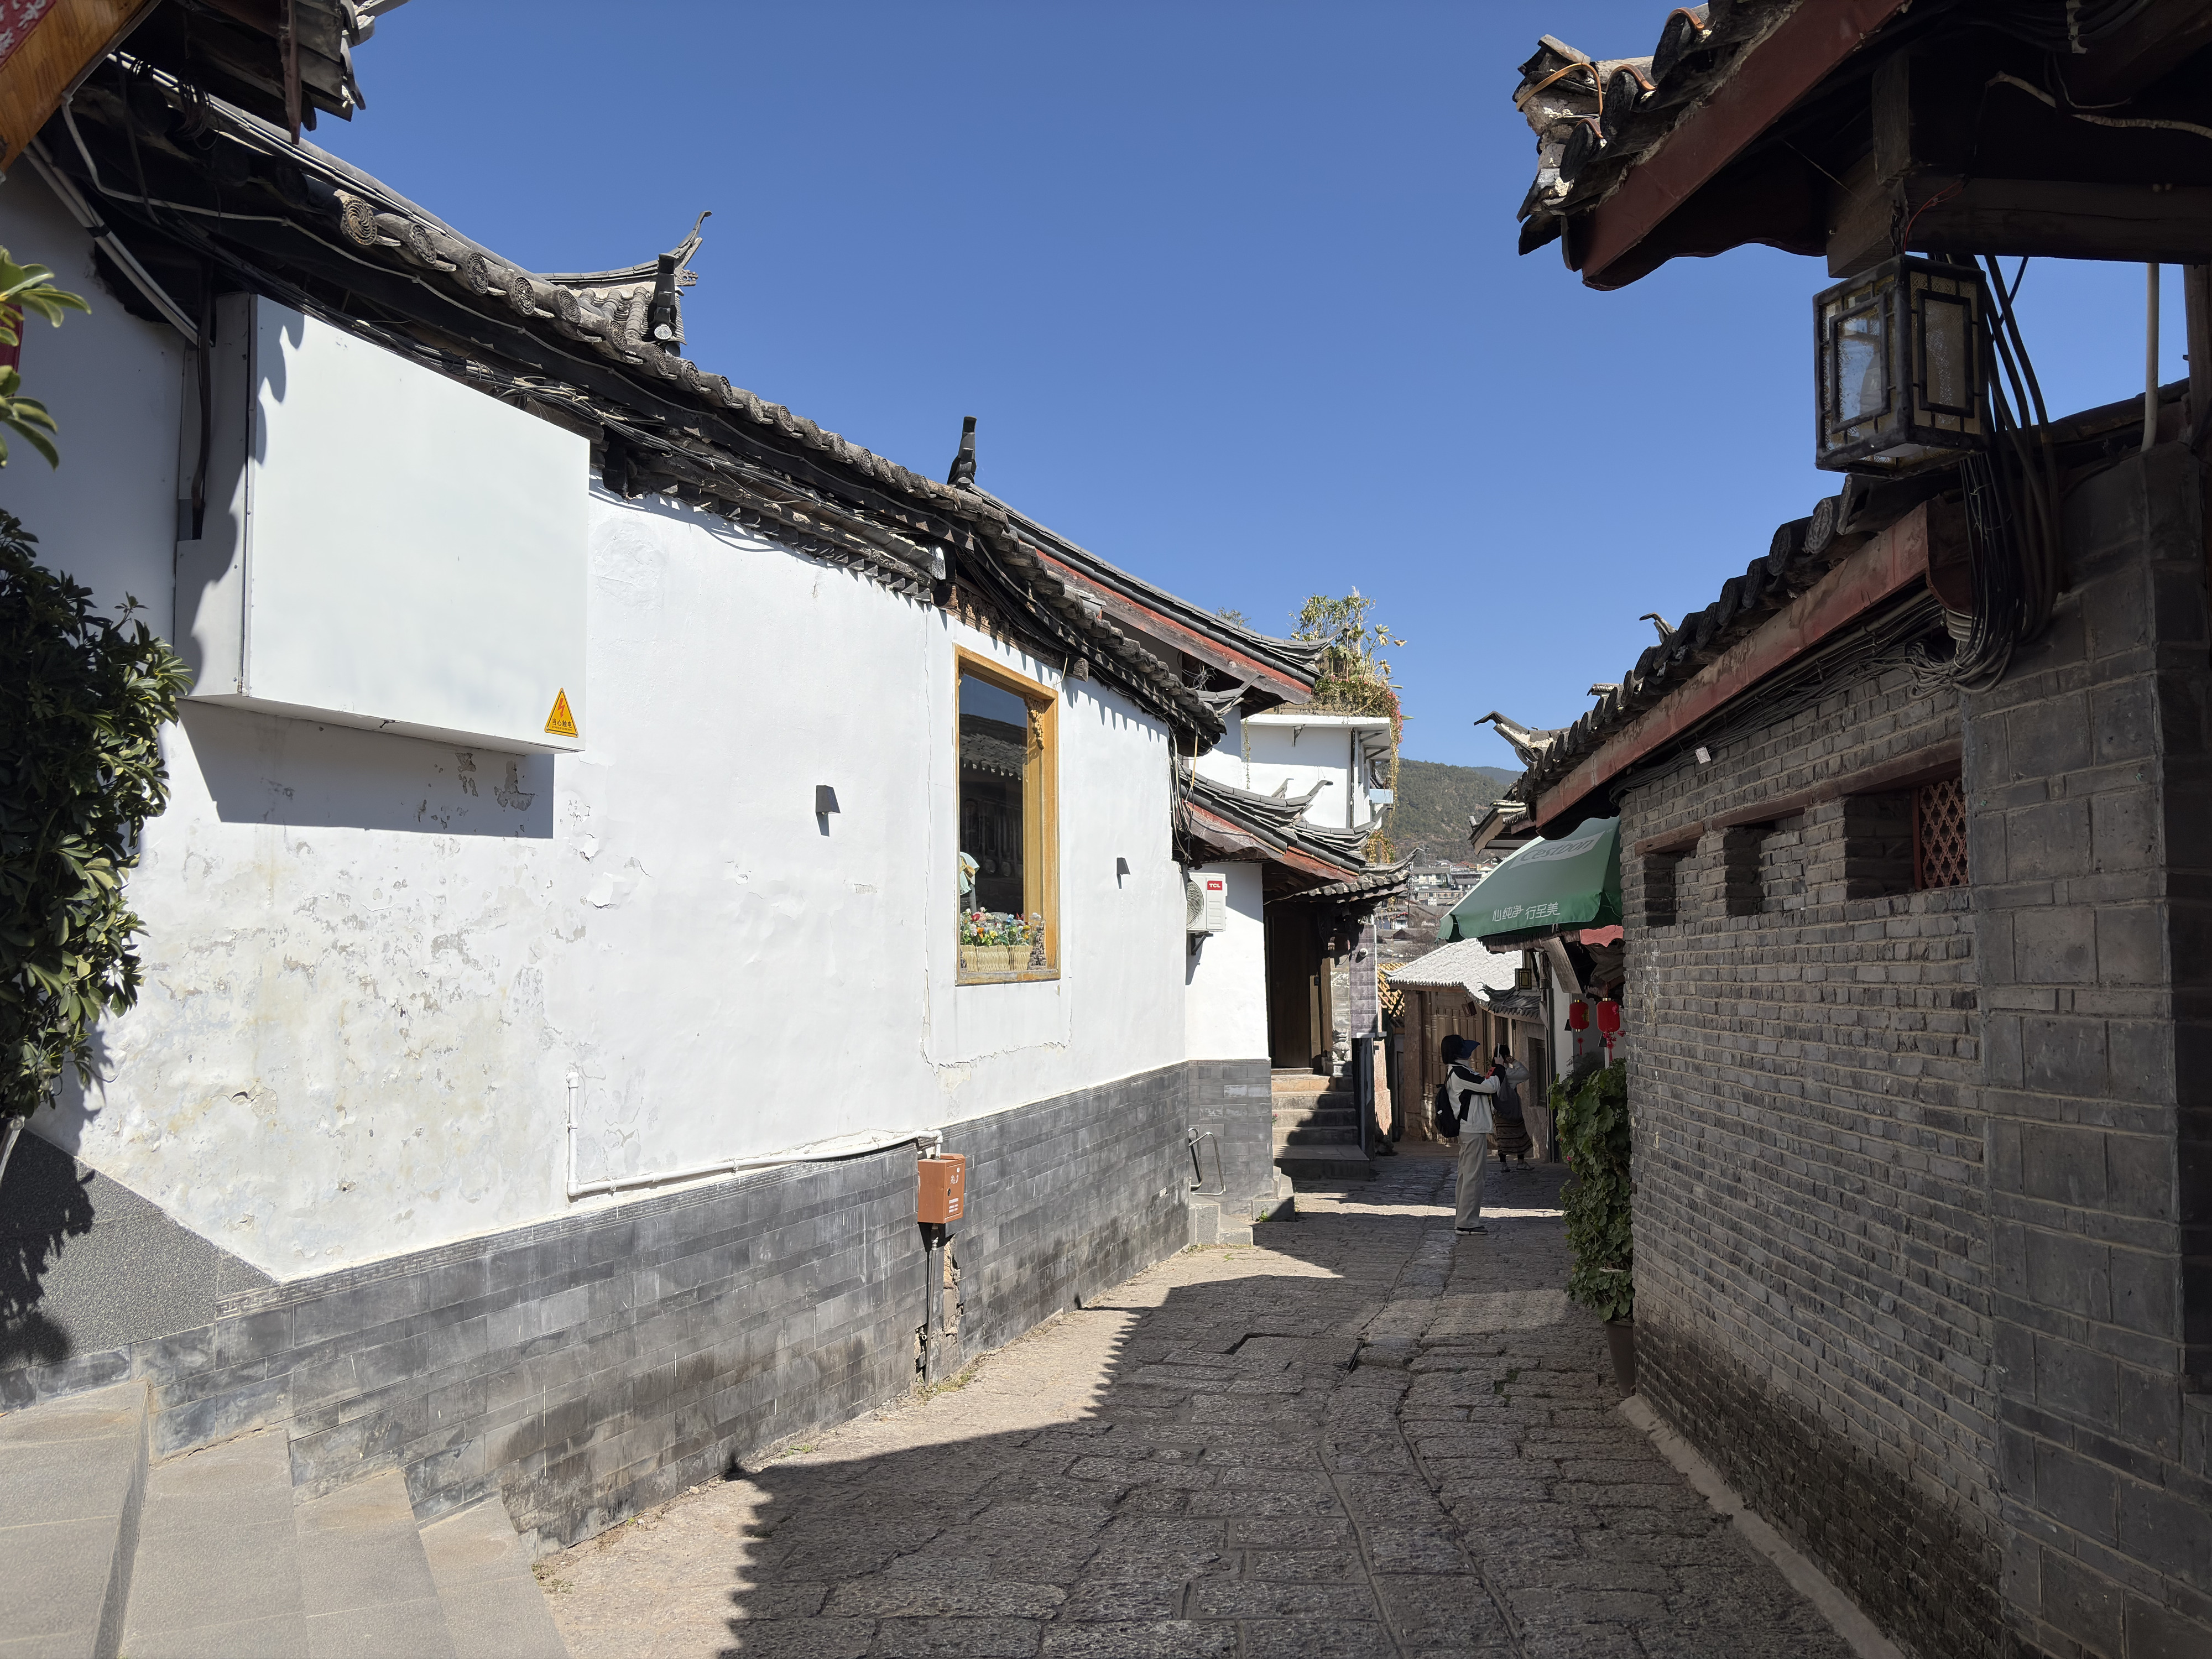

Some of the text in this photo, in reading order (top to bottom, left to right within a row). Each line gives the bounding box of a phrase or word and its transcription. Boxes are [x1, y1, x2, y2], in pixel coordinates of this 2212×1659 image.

[552, 718, 572, 728] 当心触电
[1492, 901, 1561, 922] 心纯净 行至美
